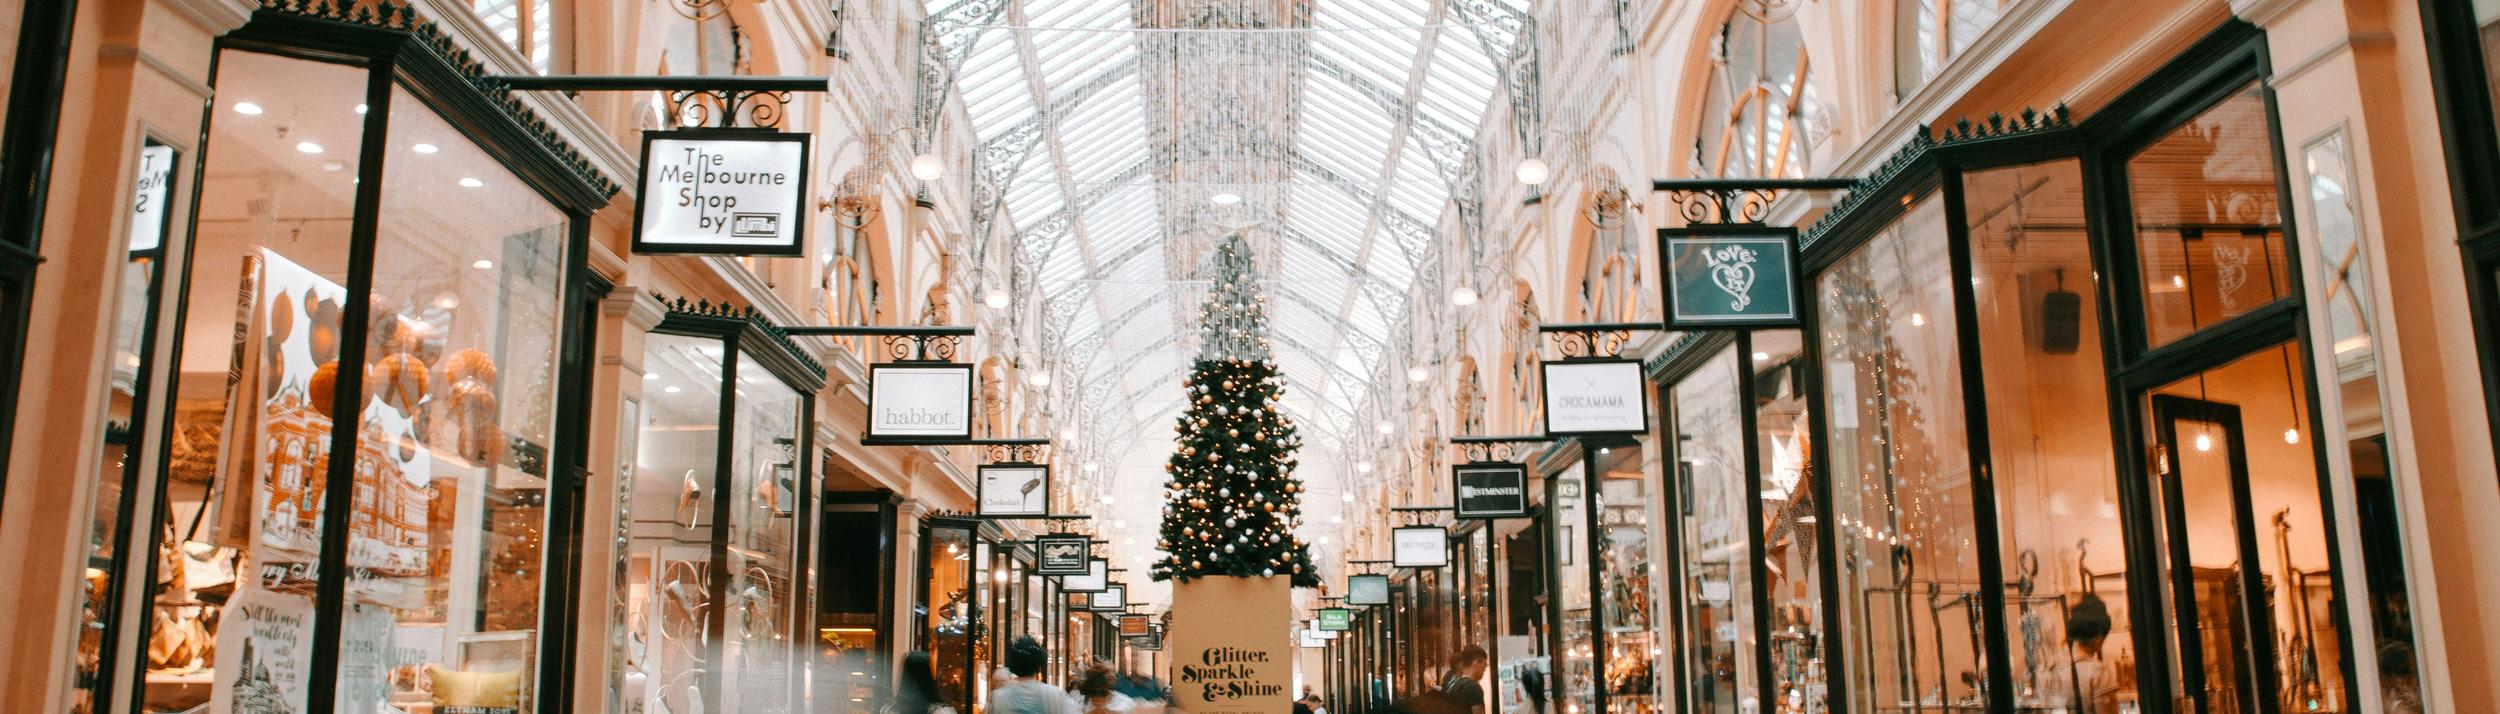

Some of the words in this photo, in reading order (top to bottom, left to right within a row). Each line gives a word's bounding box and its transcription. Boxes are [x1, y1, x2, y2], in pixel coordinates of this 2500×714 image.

[684, 147, 723, 166] The
[659, 164, 785, 185] Melbourne
[678, 187, 737, 213] Shop
[699, 213, 727, 234] by
[885, 407, 955, 425] habbot.
[1202, 647, 1269, 667] Glitter.
[1181, 664, 1254, 684] Sparkle
